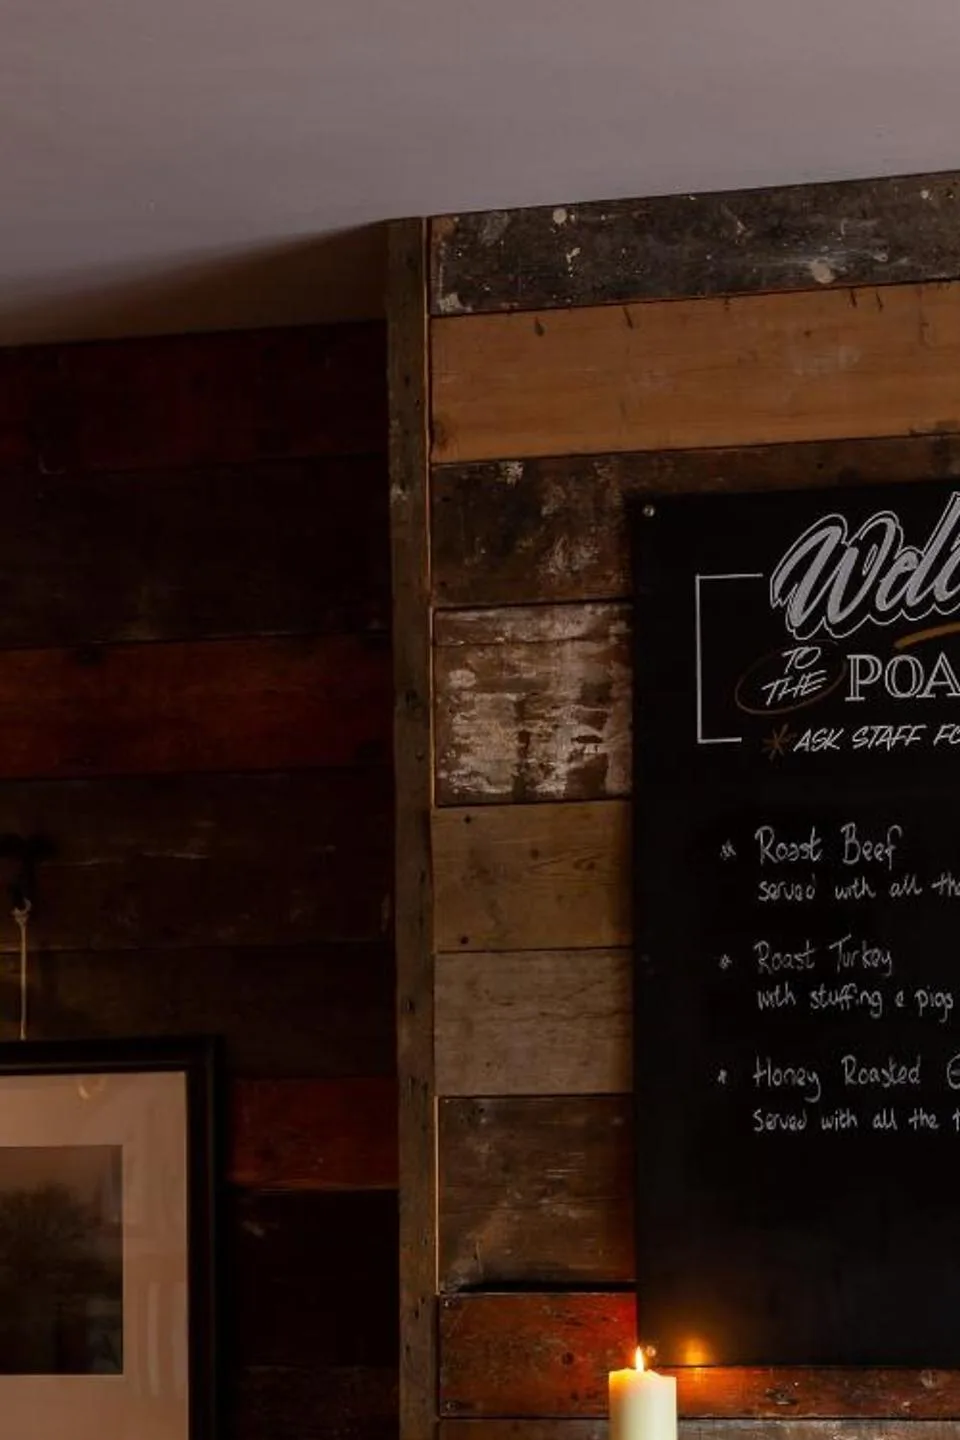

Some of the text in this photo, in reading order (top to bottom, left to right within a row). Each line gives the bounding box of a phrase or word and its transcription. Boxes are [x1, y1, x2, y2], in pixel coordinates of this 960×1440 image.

[781, 646, 822, 672] TO
[761, 670, 828, 706] THE
[793, 728, 844, 751] ASK
[852, 725, 928, 751] STAFF
[754, 822, 903, 872] Roast Beef
[834, 876, 877, 900] with
[889, 874, 923, 898] all
[753, 934, 893, 977] Roast Turkey
[757, 981, 796, 1011] with
[810, 983, 883, 1019] stuffing
[914, 986, 954, 1023] pigs
[752, 1056, 822, 1103] Honey
[840, 1054, 922, 1088] Roasted
[821, 1108, 859, 1132] with
[872, 1108, 898, 1131] all
[908, 1108, 940, 1132] the
